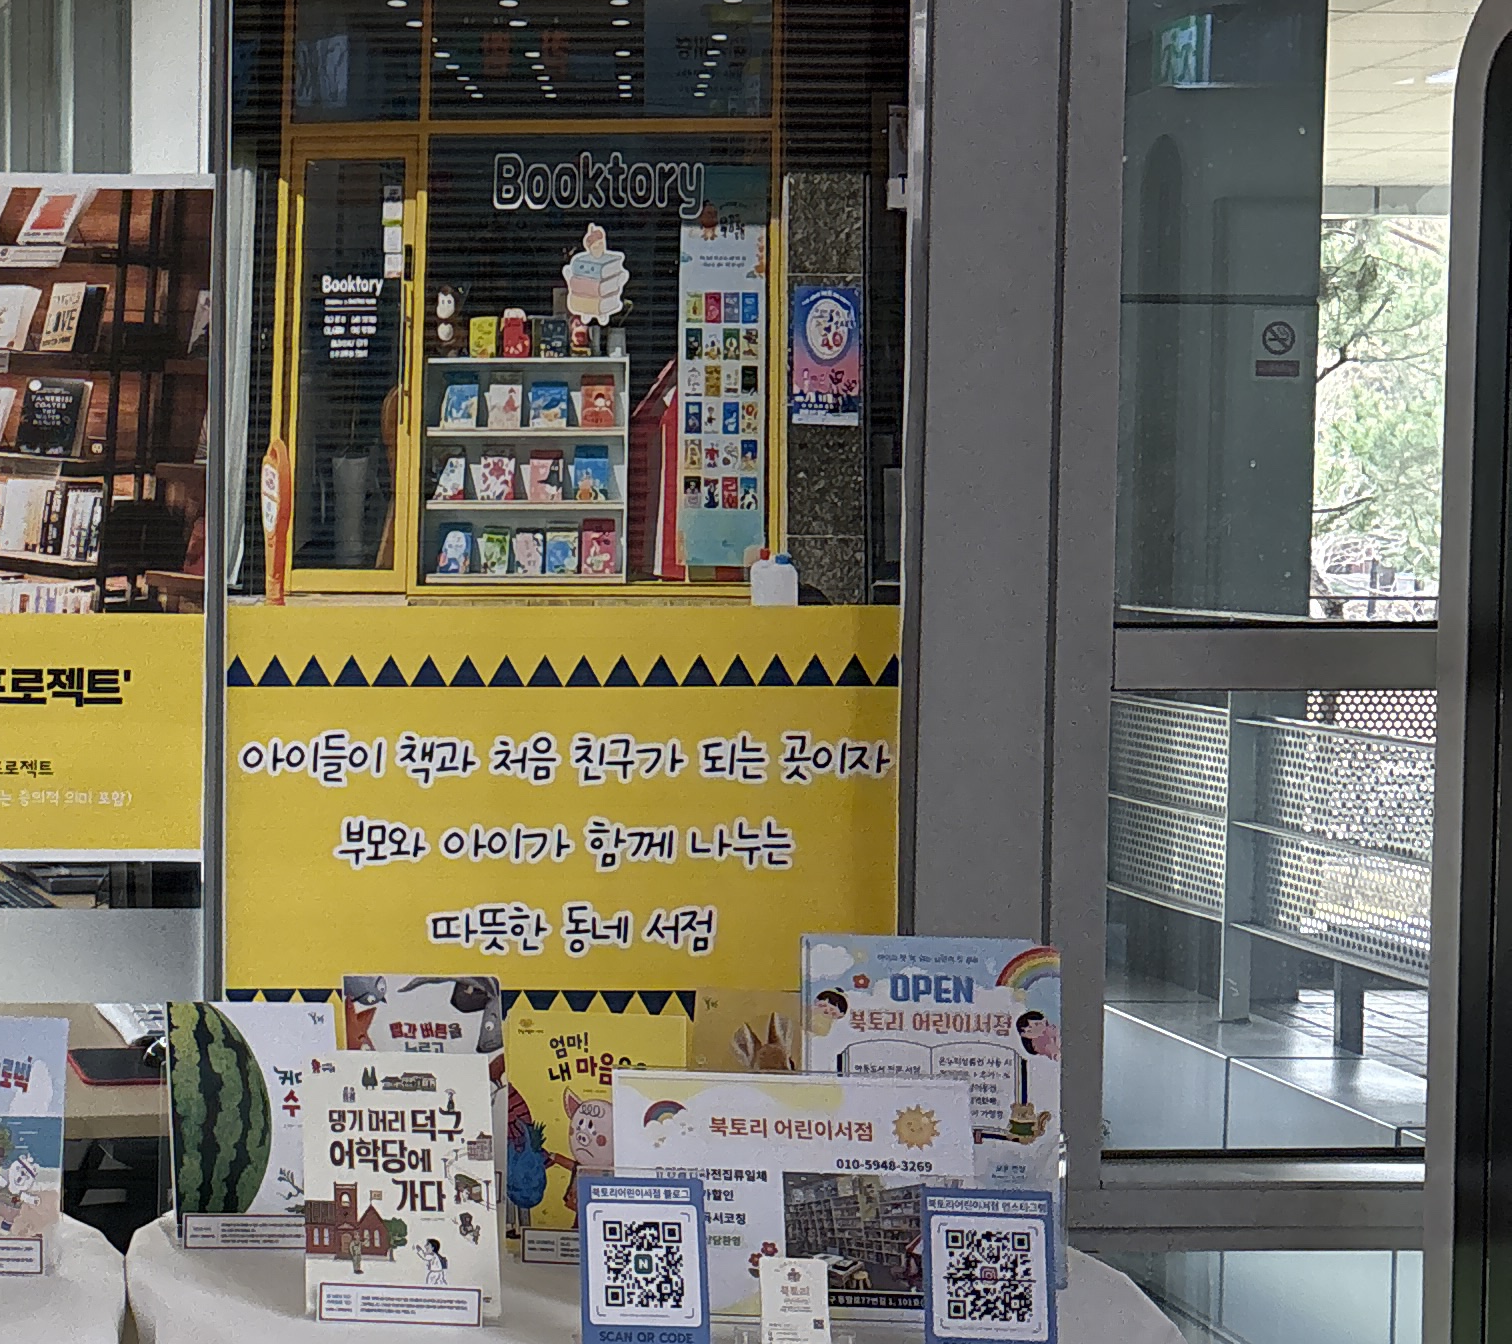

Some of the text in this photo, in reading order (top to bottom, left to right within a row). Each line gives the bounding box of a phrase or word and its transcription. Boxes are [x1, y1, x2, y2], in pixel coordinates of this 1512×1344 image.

[492, 150, 706, 218] Booktory
[321, 274, 384, 296] Booktory
[242, 734, 891, 783] 아이들이 책과 처음 친구가 되는 곳이자
[339, 819, 792, 868] 부모와 아이가 함께 나누는
[431, 905, 716, 953] 따뜻한 동네 서점
[889, 973, 975, 1004] OPEN
[849, 1009, 1013, 1036] 북토리 어린이서점
[547, 1061, 573, 1084] 내
[328, 1108, 465, 1143] 댕기 머리 덕구,
[709, 1116, 875, 1143] 북토리 어린이서점
[329, 1139, 433, 1174] 어학당에
[836, 1158, 933, 1173] 010-5948-3269
[395, 1179, 447, 1213] 가다
[599, 1331, 633, 1343] SCAN
[659, 1332, 694, 1344] CODE
